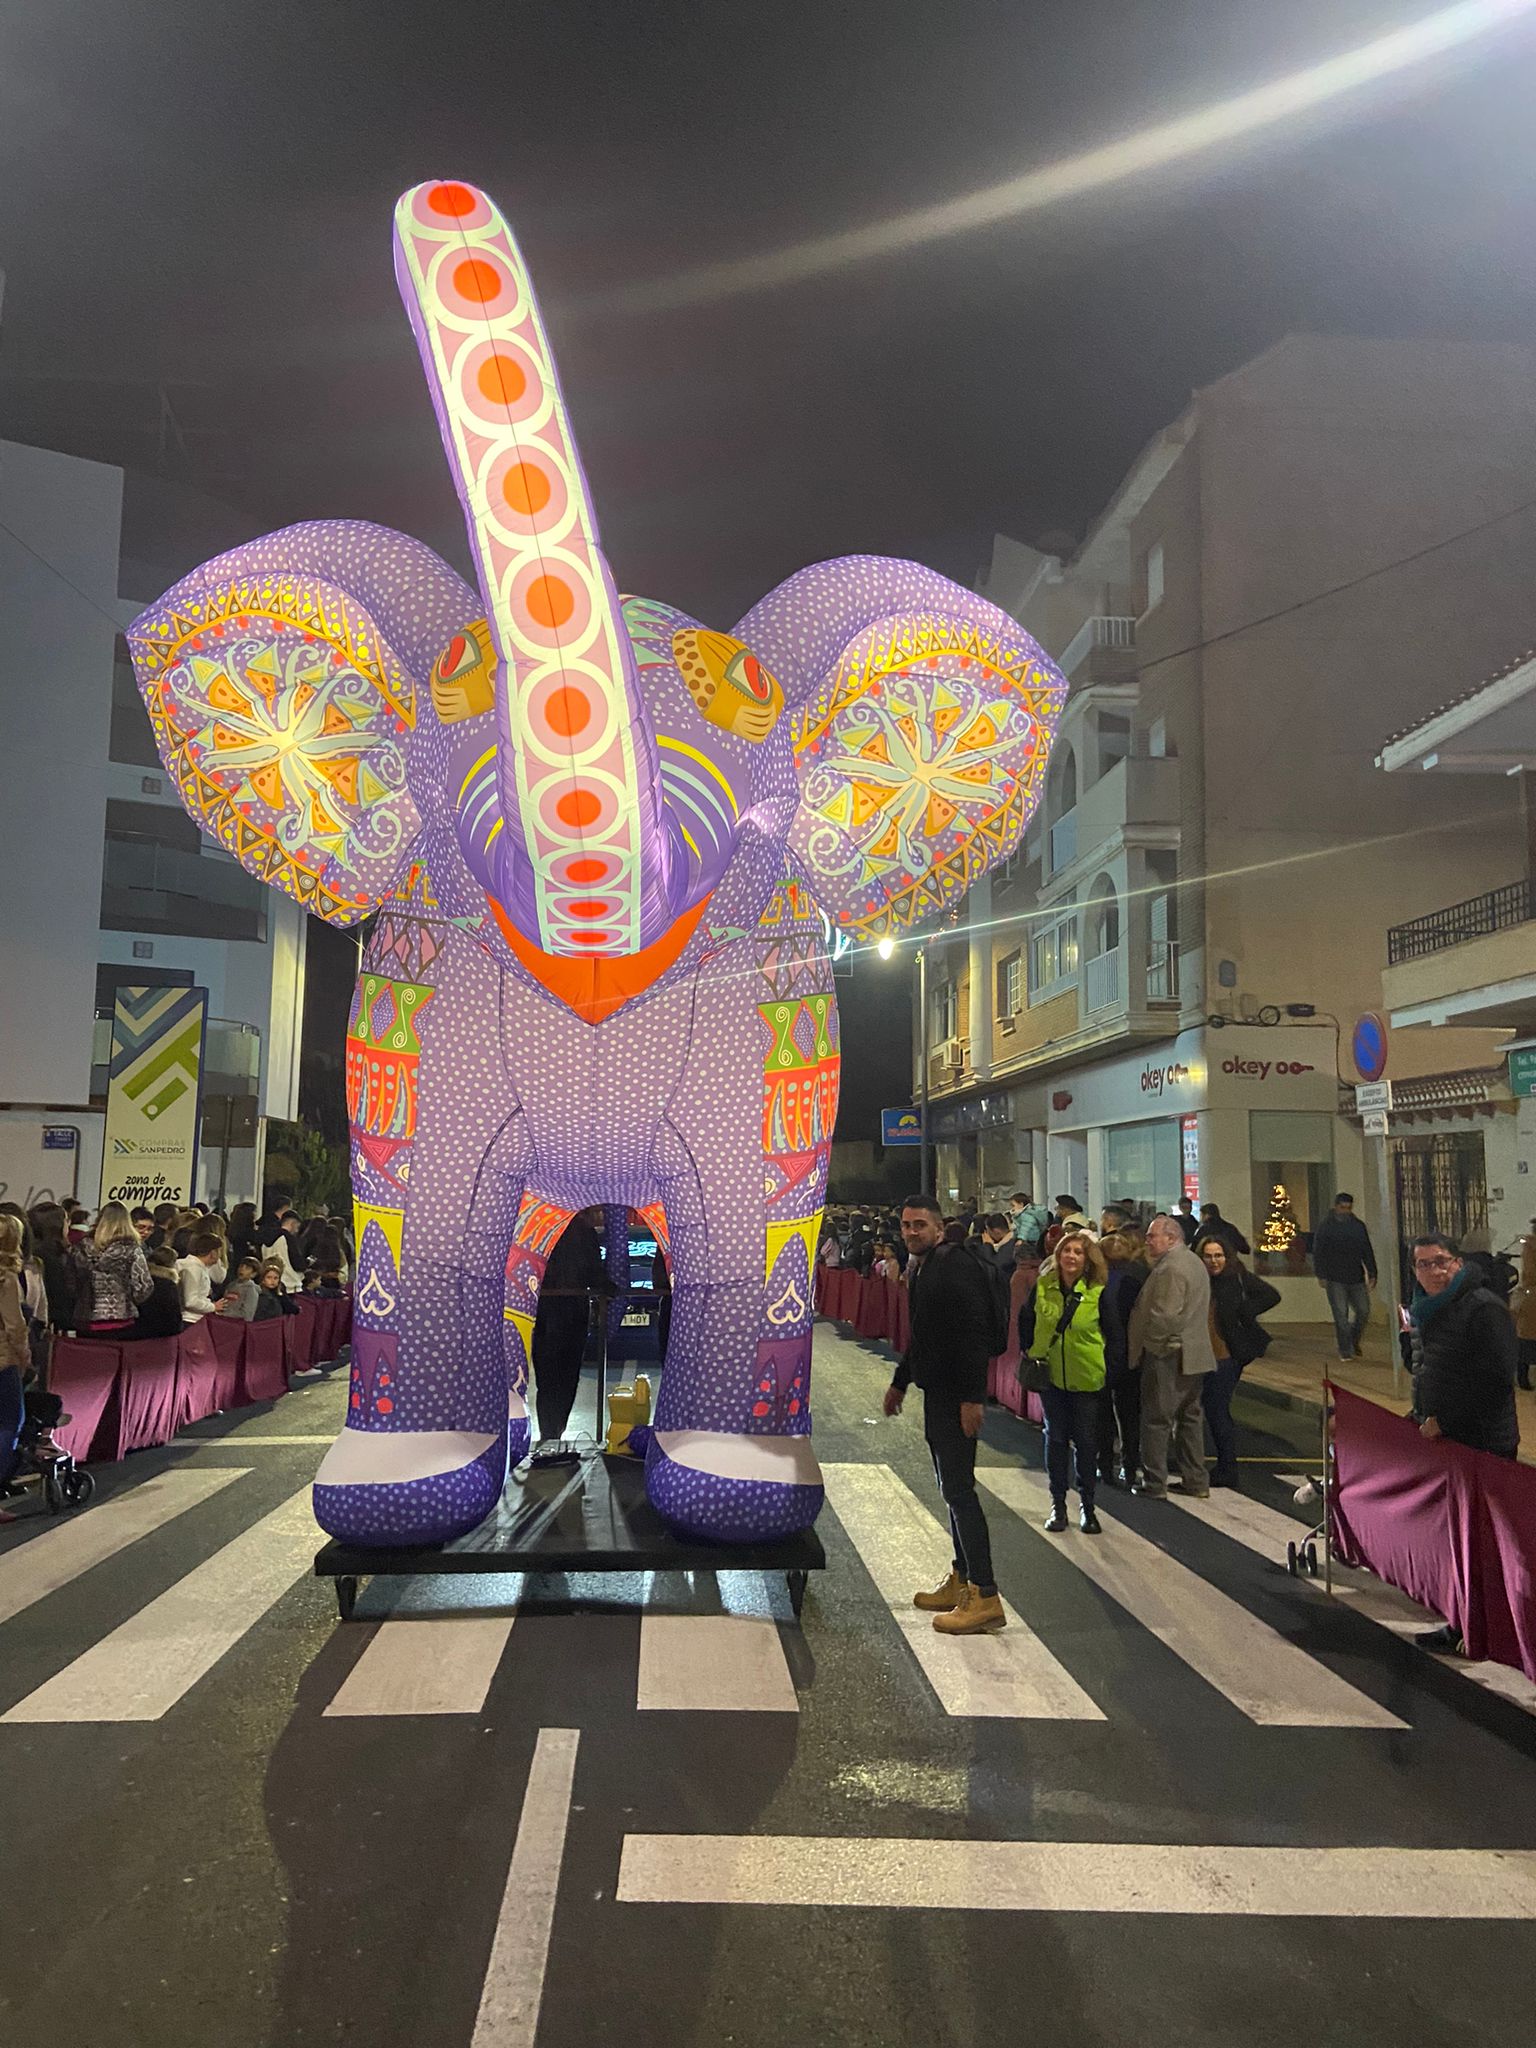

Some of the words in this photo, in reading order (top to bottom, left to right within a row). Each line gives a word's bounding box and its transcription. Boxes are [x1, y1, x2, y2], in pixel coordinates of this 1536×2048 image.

[1222, 1055, 1271, 1080] okey
[1141, 1062, 1165, 1096] okey
[139, 1139, 185, 1147] COMPRAS
[125, 1175, 150, 1185] zona
[152, 1171, 166, 1185] de
[108, 1186, 182, 1205] compras
